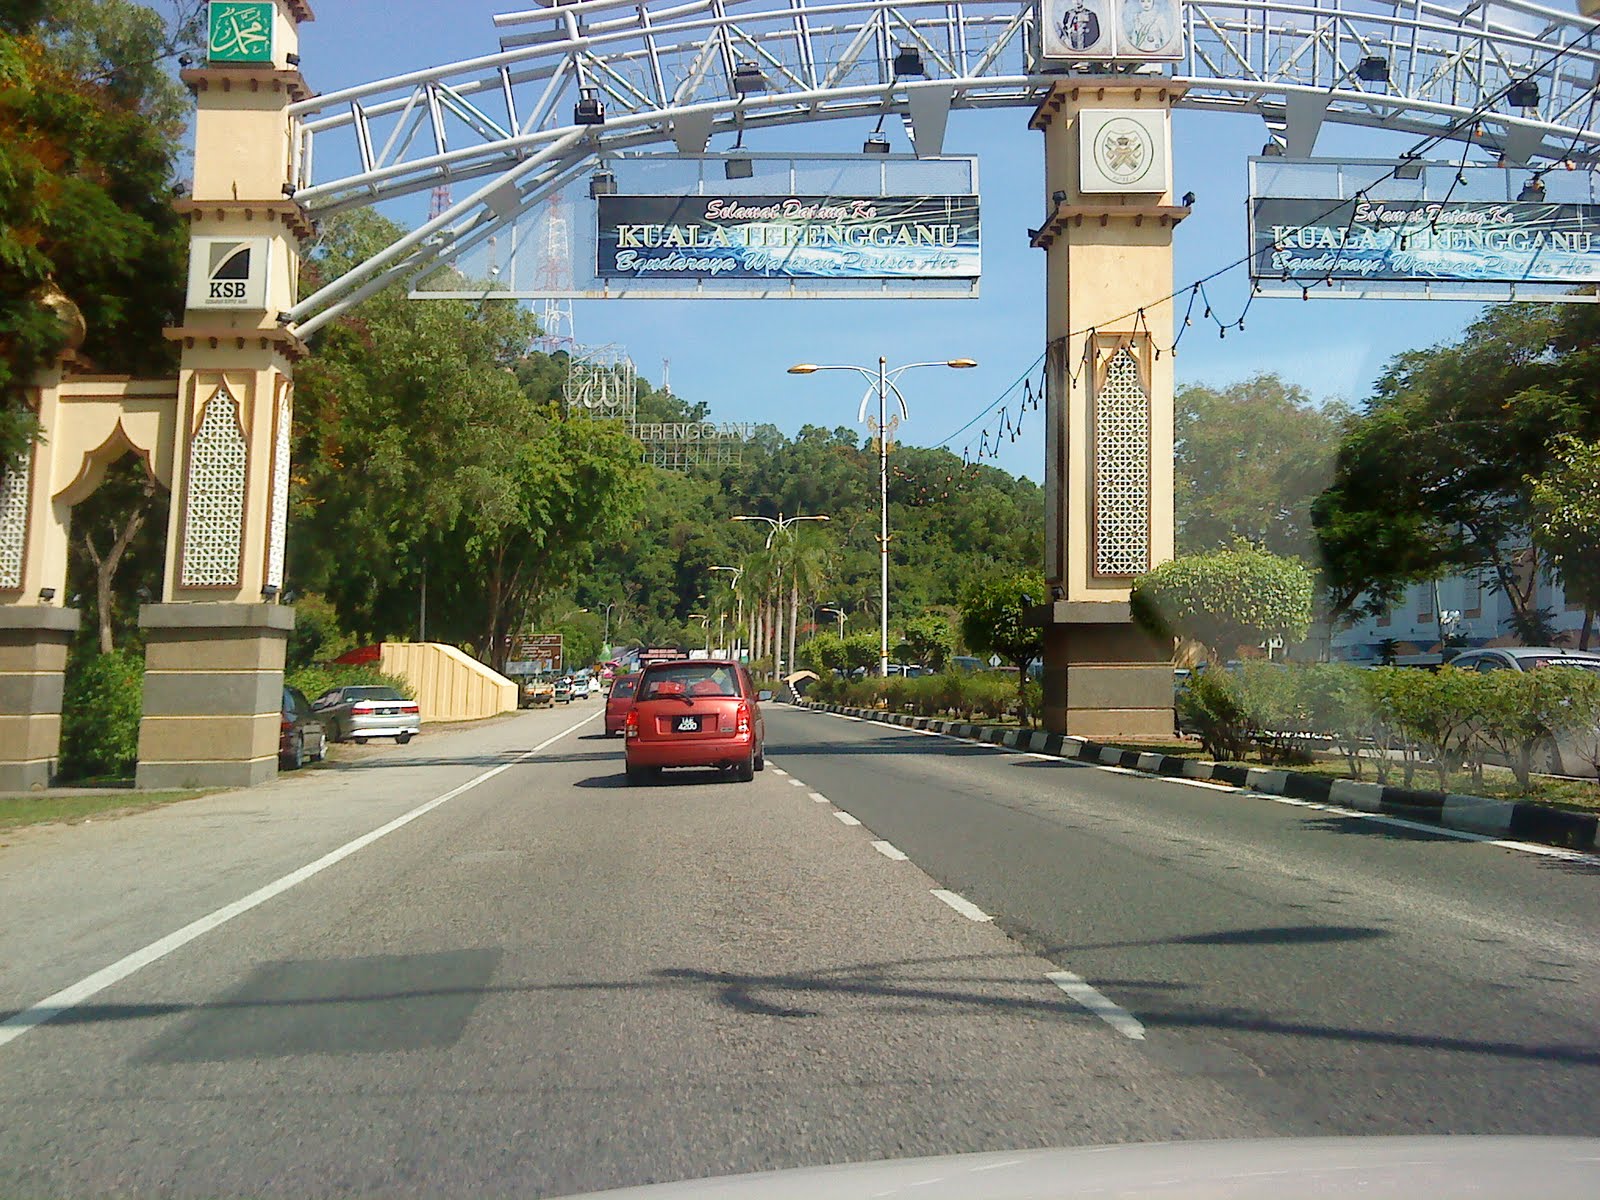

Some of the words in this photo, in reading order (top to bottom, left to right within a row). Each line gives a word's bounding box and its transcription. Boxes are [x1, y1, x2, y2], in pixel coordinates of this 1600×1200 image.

[705, 199, 780, 220] Selamat
[782, 199, 848, 224] Datang
[851, 200, 877, 219] Ke
[1354, 203, 1424, 223] Selamat
[1425, 204, 1487, 229] Datang
[1488, 206, 1514, 224] Ke
[615, 224, 731, 248] KUALA
[735, 223, 960, 248] TERENGGANU
[1271, 225, 1380, 250] KUALA
[1382, 227, 1593, 254] TERENGGANU
[615, 250, 737, 276] Bandaraya
[741, 252, 837, 272] Warisan
[841, 251, 918, 271] Pesisir
[918, 249, 960, 271] Air
[1271, 250, 1385, 276] Bandaraya
[1390, 253, 1479, 273] Warisan
[1482, 255, 1553, 275] Pesisir
[1554, 255, 1593, 275] Air
[209, 282, 246, 298] KSB
[630, 422, 757, 440] TERENGGANU
